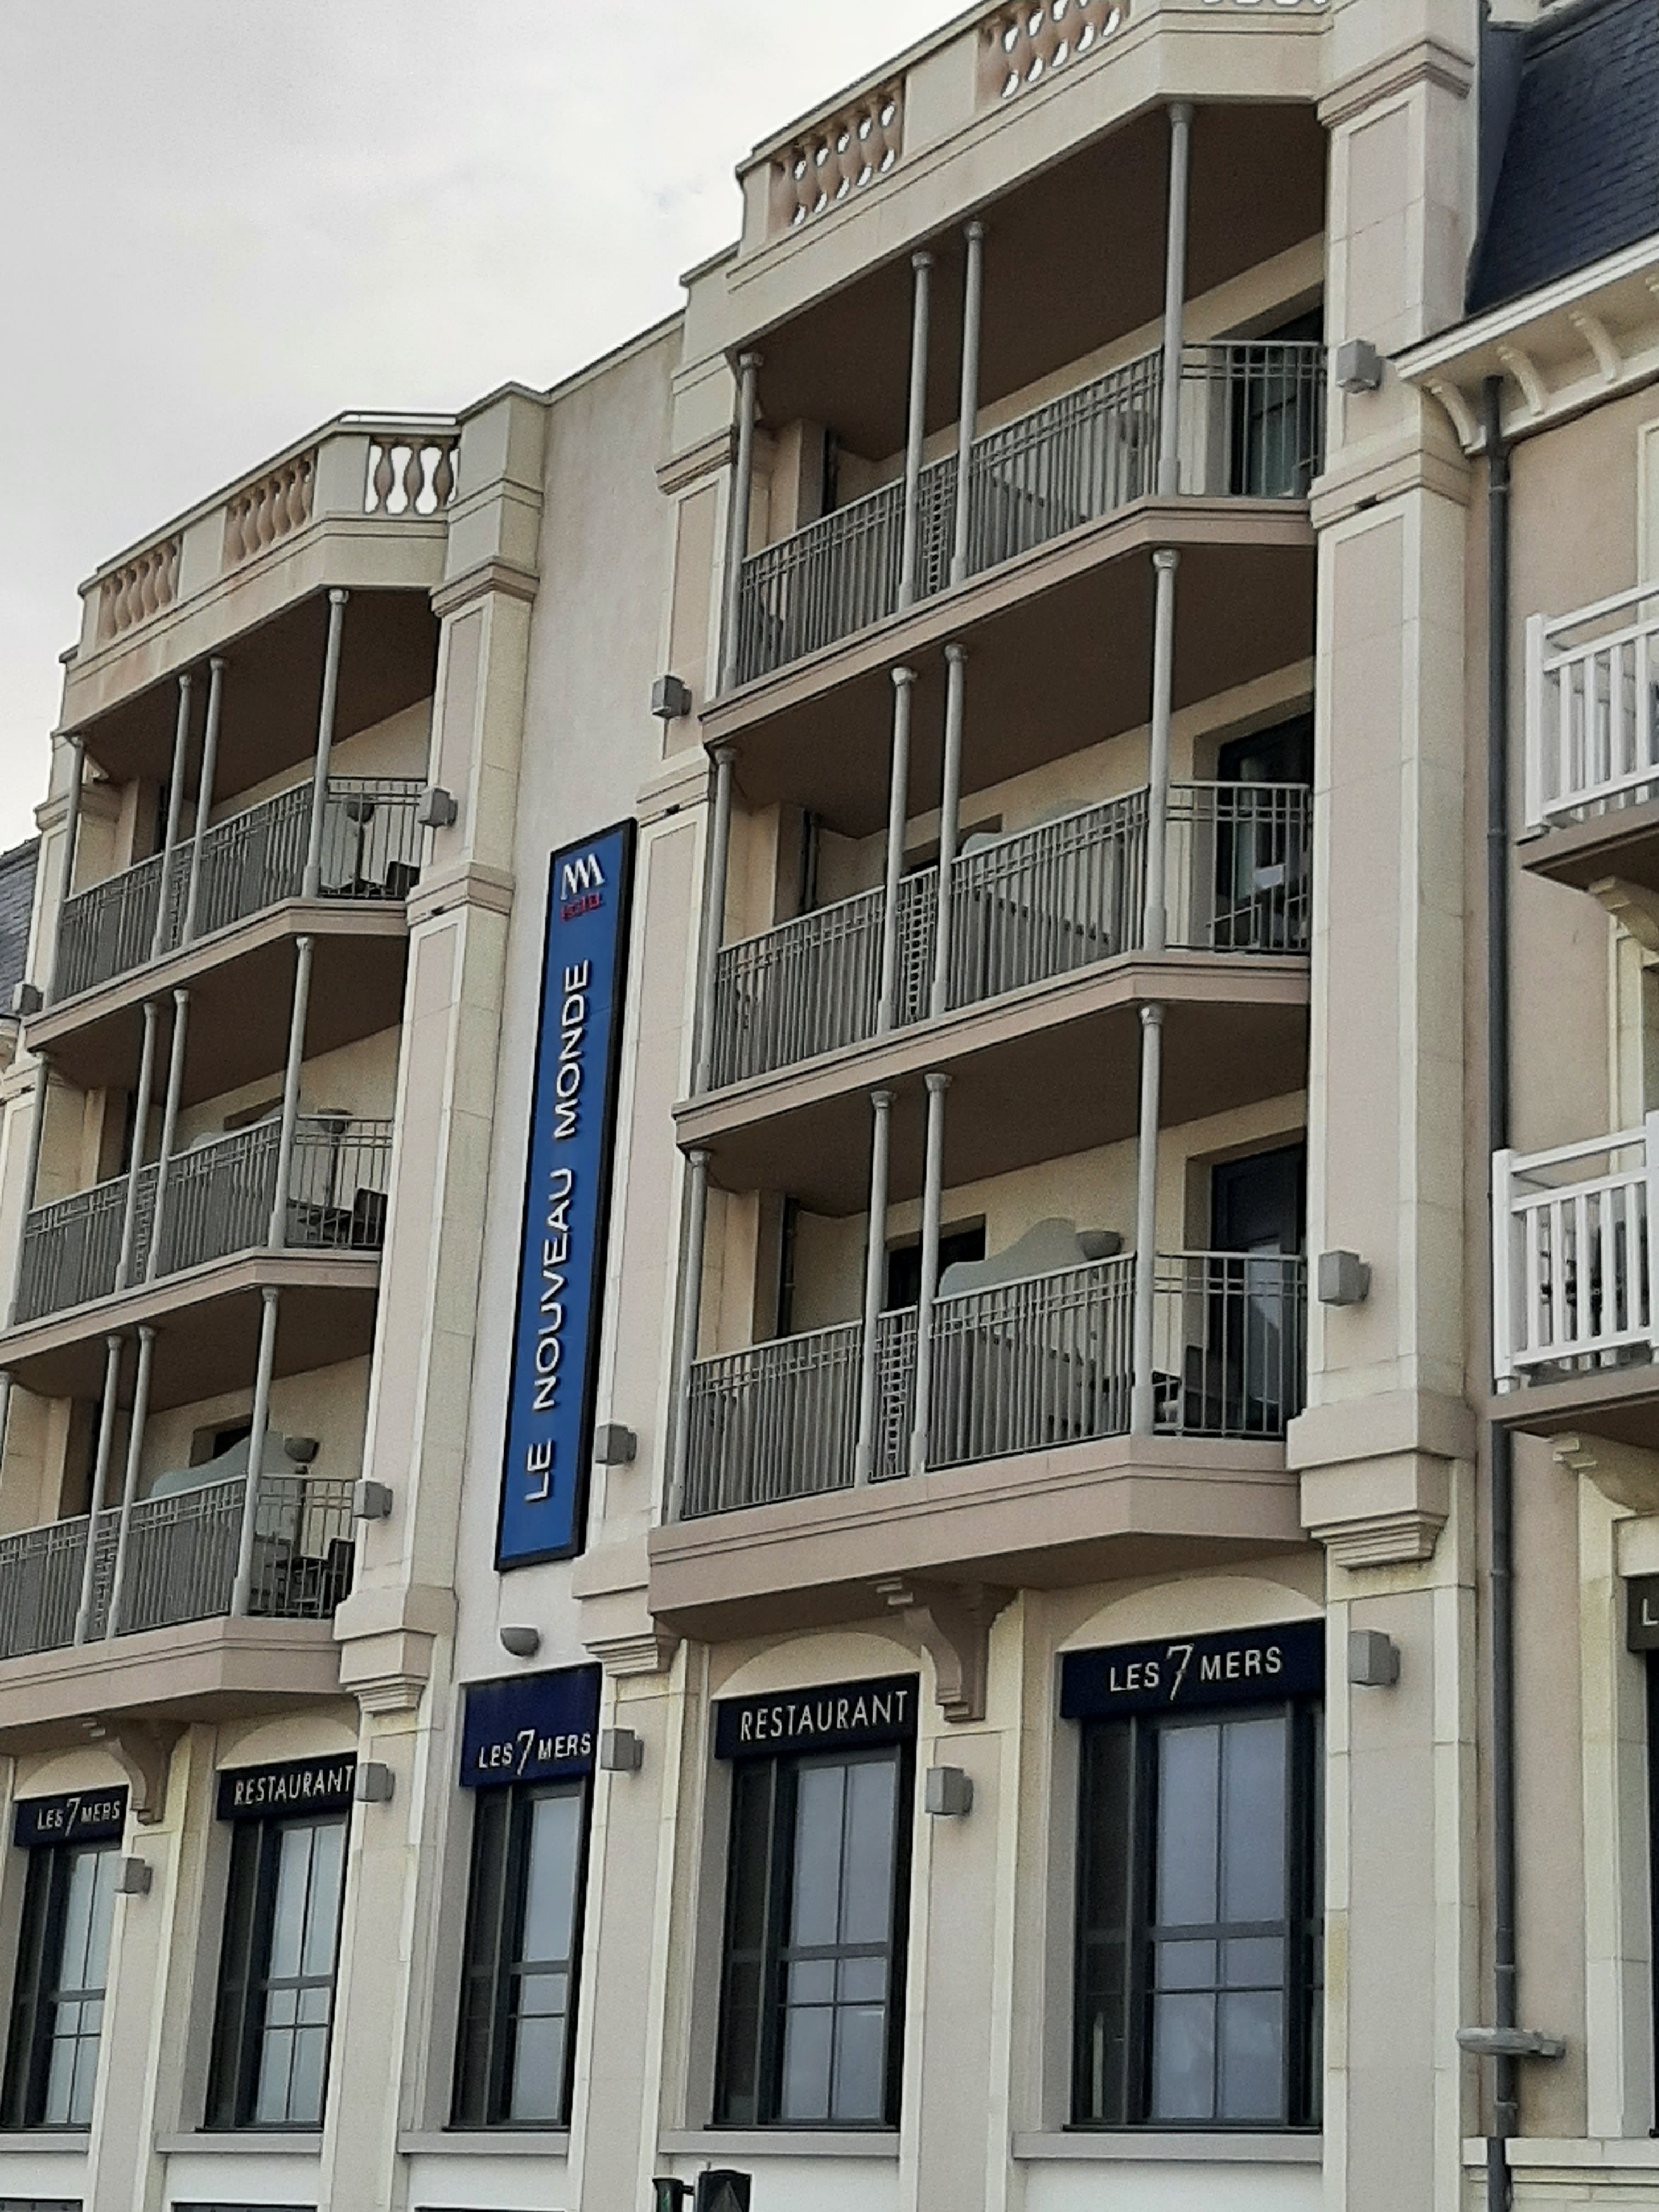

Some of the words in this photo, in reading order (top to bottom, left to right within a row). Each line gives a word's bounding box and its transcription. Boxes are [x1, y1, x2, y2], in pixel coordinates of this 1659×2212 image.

[553, 959, 590, 1139] MONDE
[532, 1167, 573, 1411] NOUVEAU
[525, 1438, 552, 1501] LE
[1110, 1661, 1160, 1692] LES
[1166, 1644, 1194, 1700] 7
[1200, 1646, 1283, 1681] MERS
[741, 1690, 908, 1741] RESTAURANT
[479, 1742, 513, 1768] LES
[517, 1729, 535, 1776] 7
[538, 1733, 591, 1760] MERS
[234, 1765, 354, 1806] RESTAURANT
[37, 1808, 64, 1830] LES
[65, 1797, 81, 1837] 7
[81, 1800, 120, 1822] MERS
